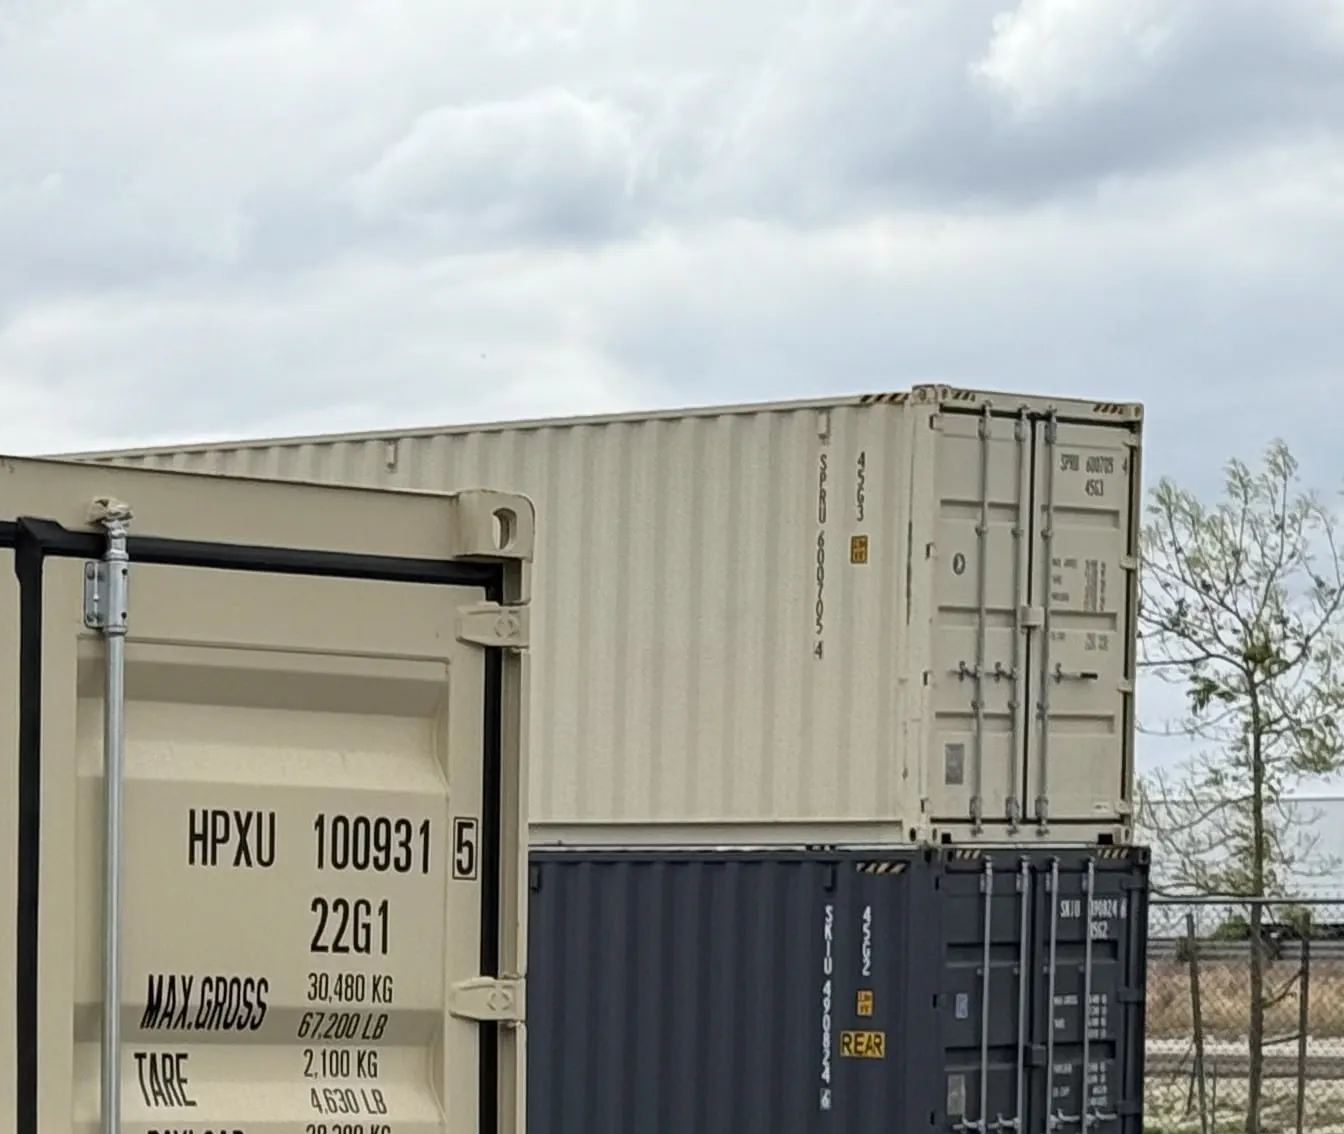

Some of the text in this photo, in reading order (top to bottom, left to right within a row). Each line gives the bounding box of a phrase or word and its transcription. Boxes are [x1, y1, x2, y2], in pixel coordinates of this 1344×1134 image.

[814, 454, 827, 660] SPRU 600705 4
[188, 808, 475, 876] HPXU 100931 5
[310, 897, 390, 955] 22G1
[825, 904, 833, 975] SKIU
[139, 973, 394, 1032] MAX.GROSS 30,480 KG
[297, 1012, 389, 1040] 67,200 LB
[822, 979, 831, 1084] 490824
[842, 1033, 882, 1054] REAR
[134, 1049, 378, 1108] TARE 2,100 KG
[310, 1087, 388, 1115] 4,630 LB
